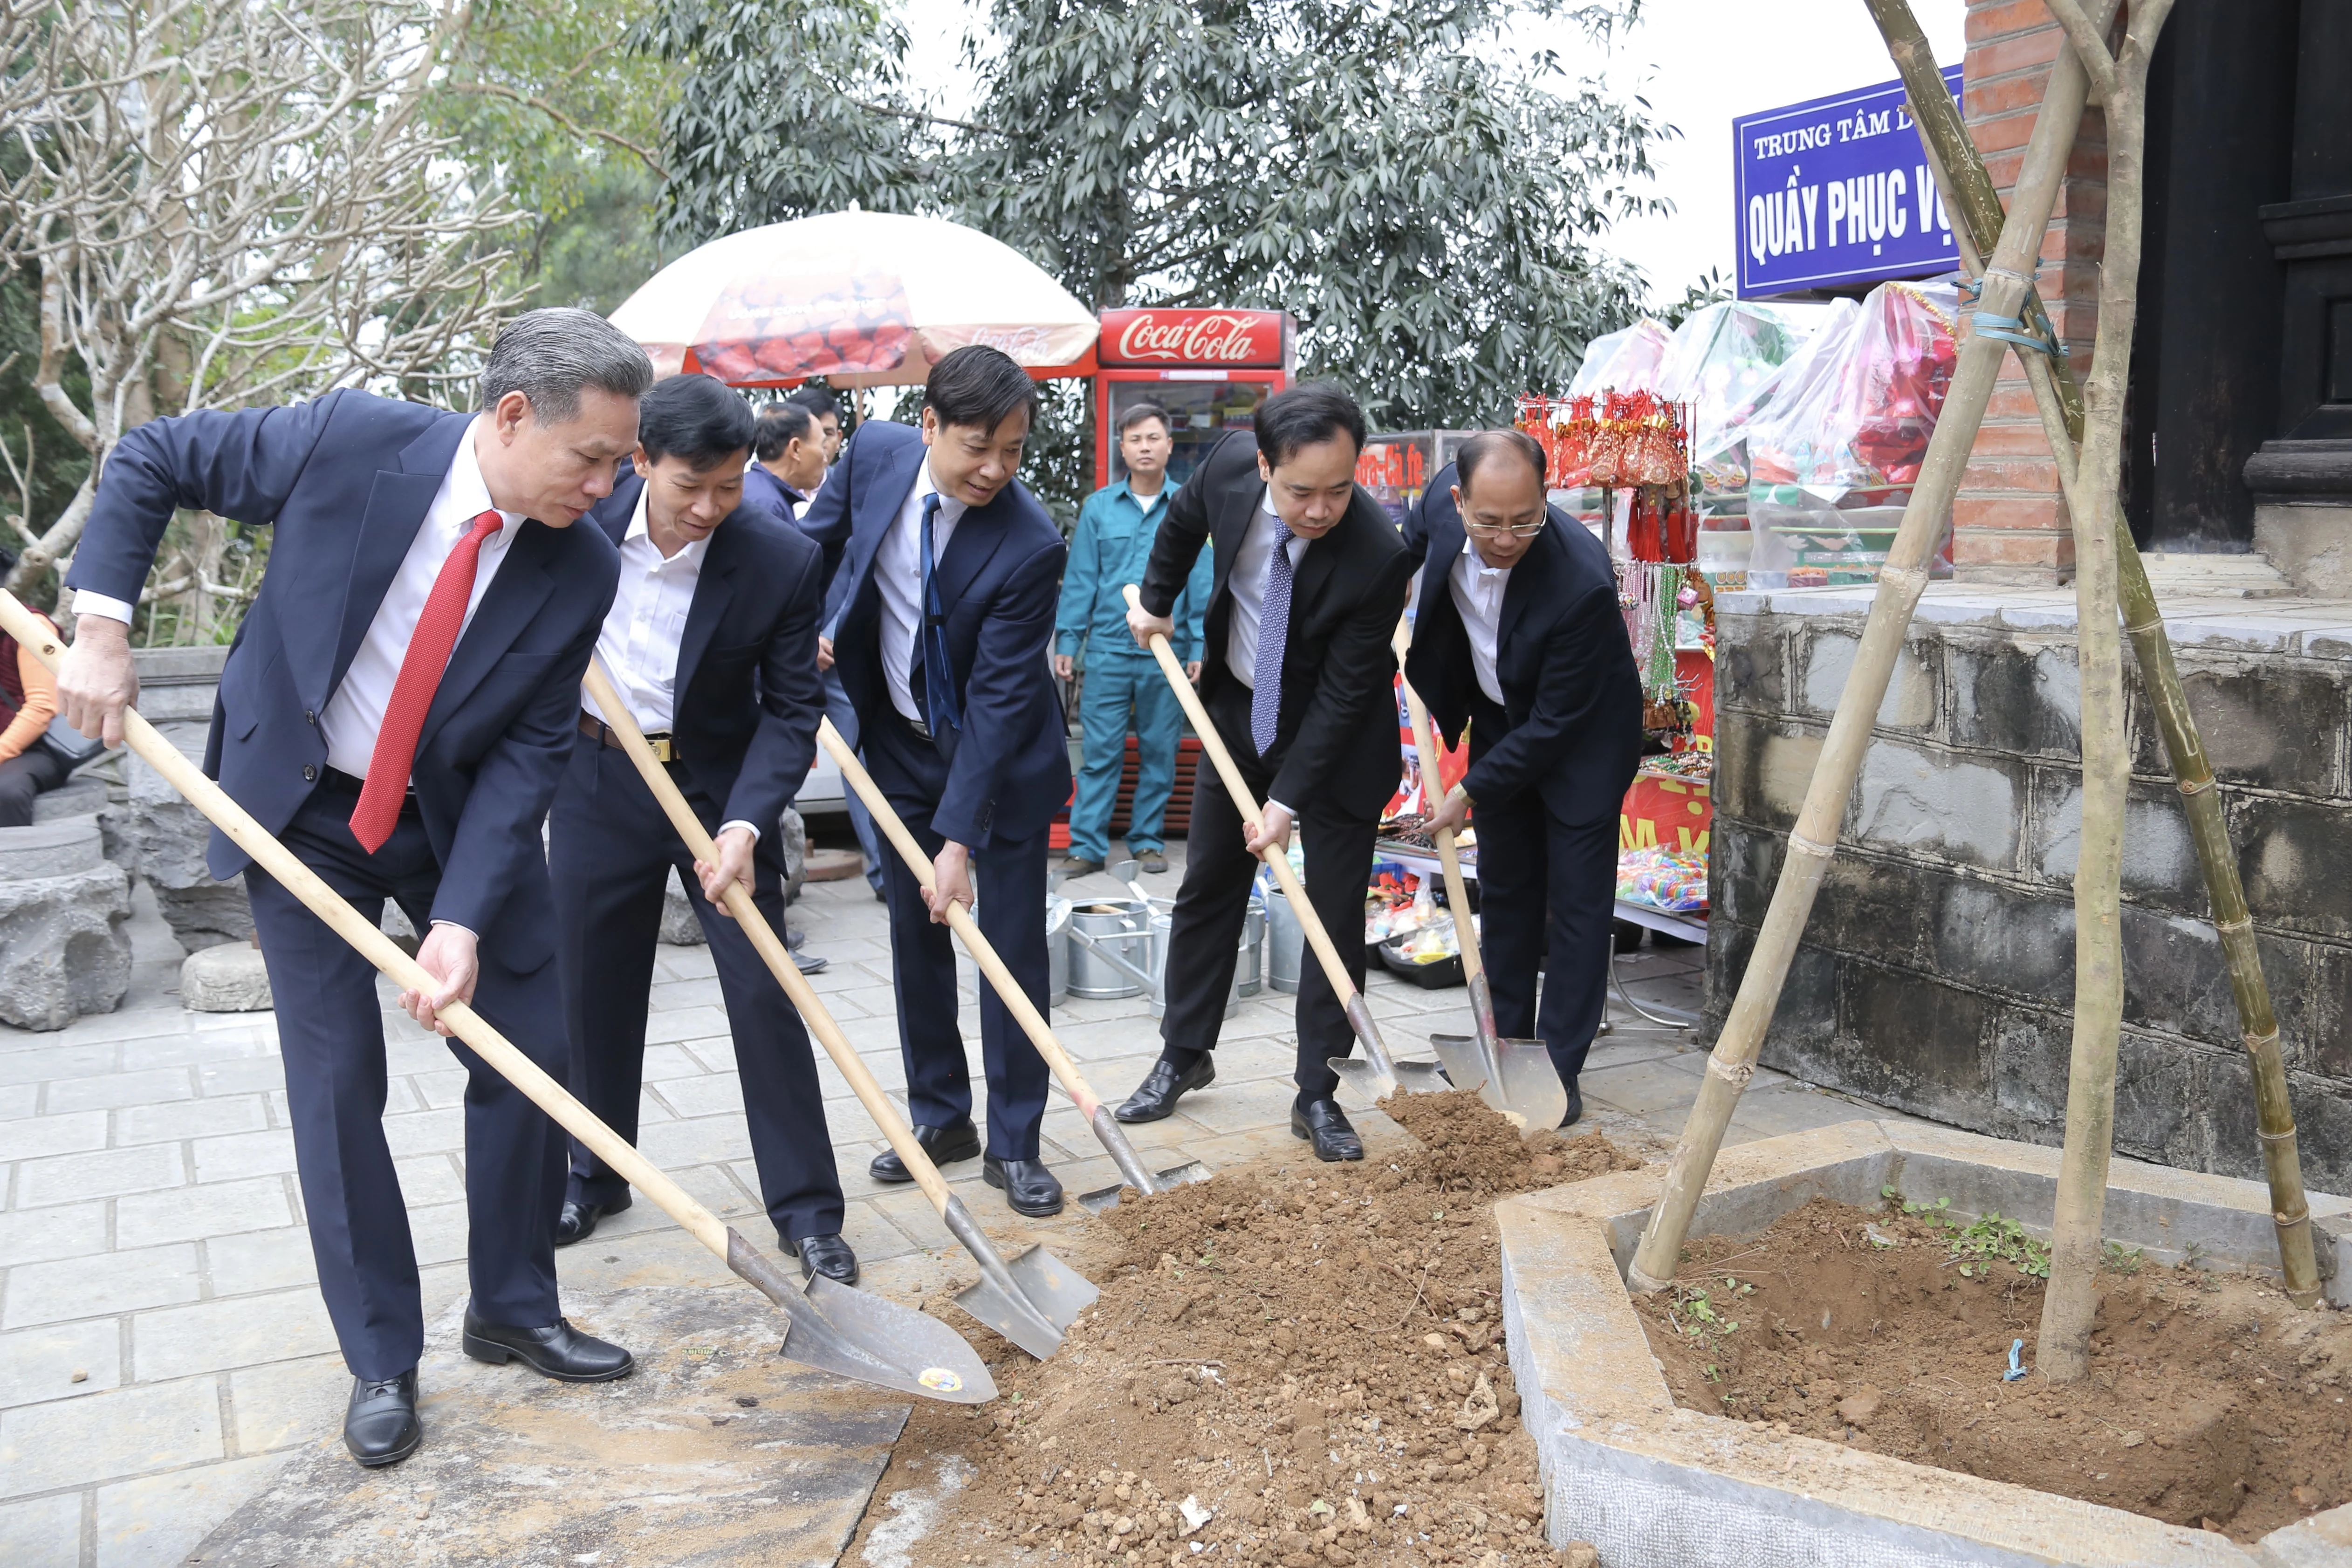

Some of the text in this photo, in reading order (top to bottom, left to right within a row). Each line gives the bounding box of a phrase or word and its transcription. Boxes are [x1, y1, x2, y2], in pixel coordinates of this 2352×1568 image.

[1754, 123, 1832, 160] TRUNG
[1837, 108, 1891, 143] TÂM
[1749, 165, 1819, 266] QUẦY
[1827, 168, 1907, 256] PHỤC
[1118, 314, 1261, 361] Coca-Cola
